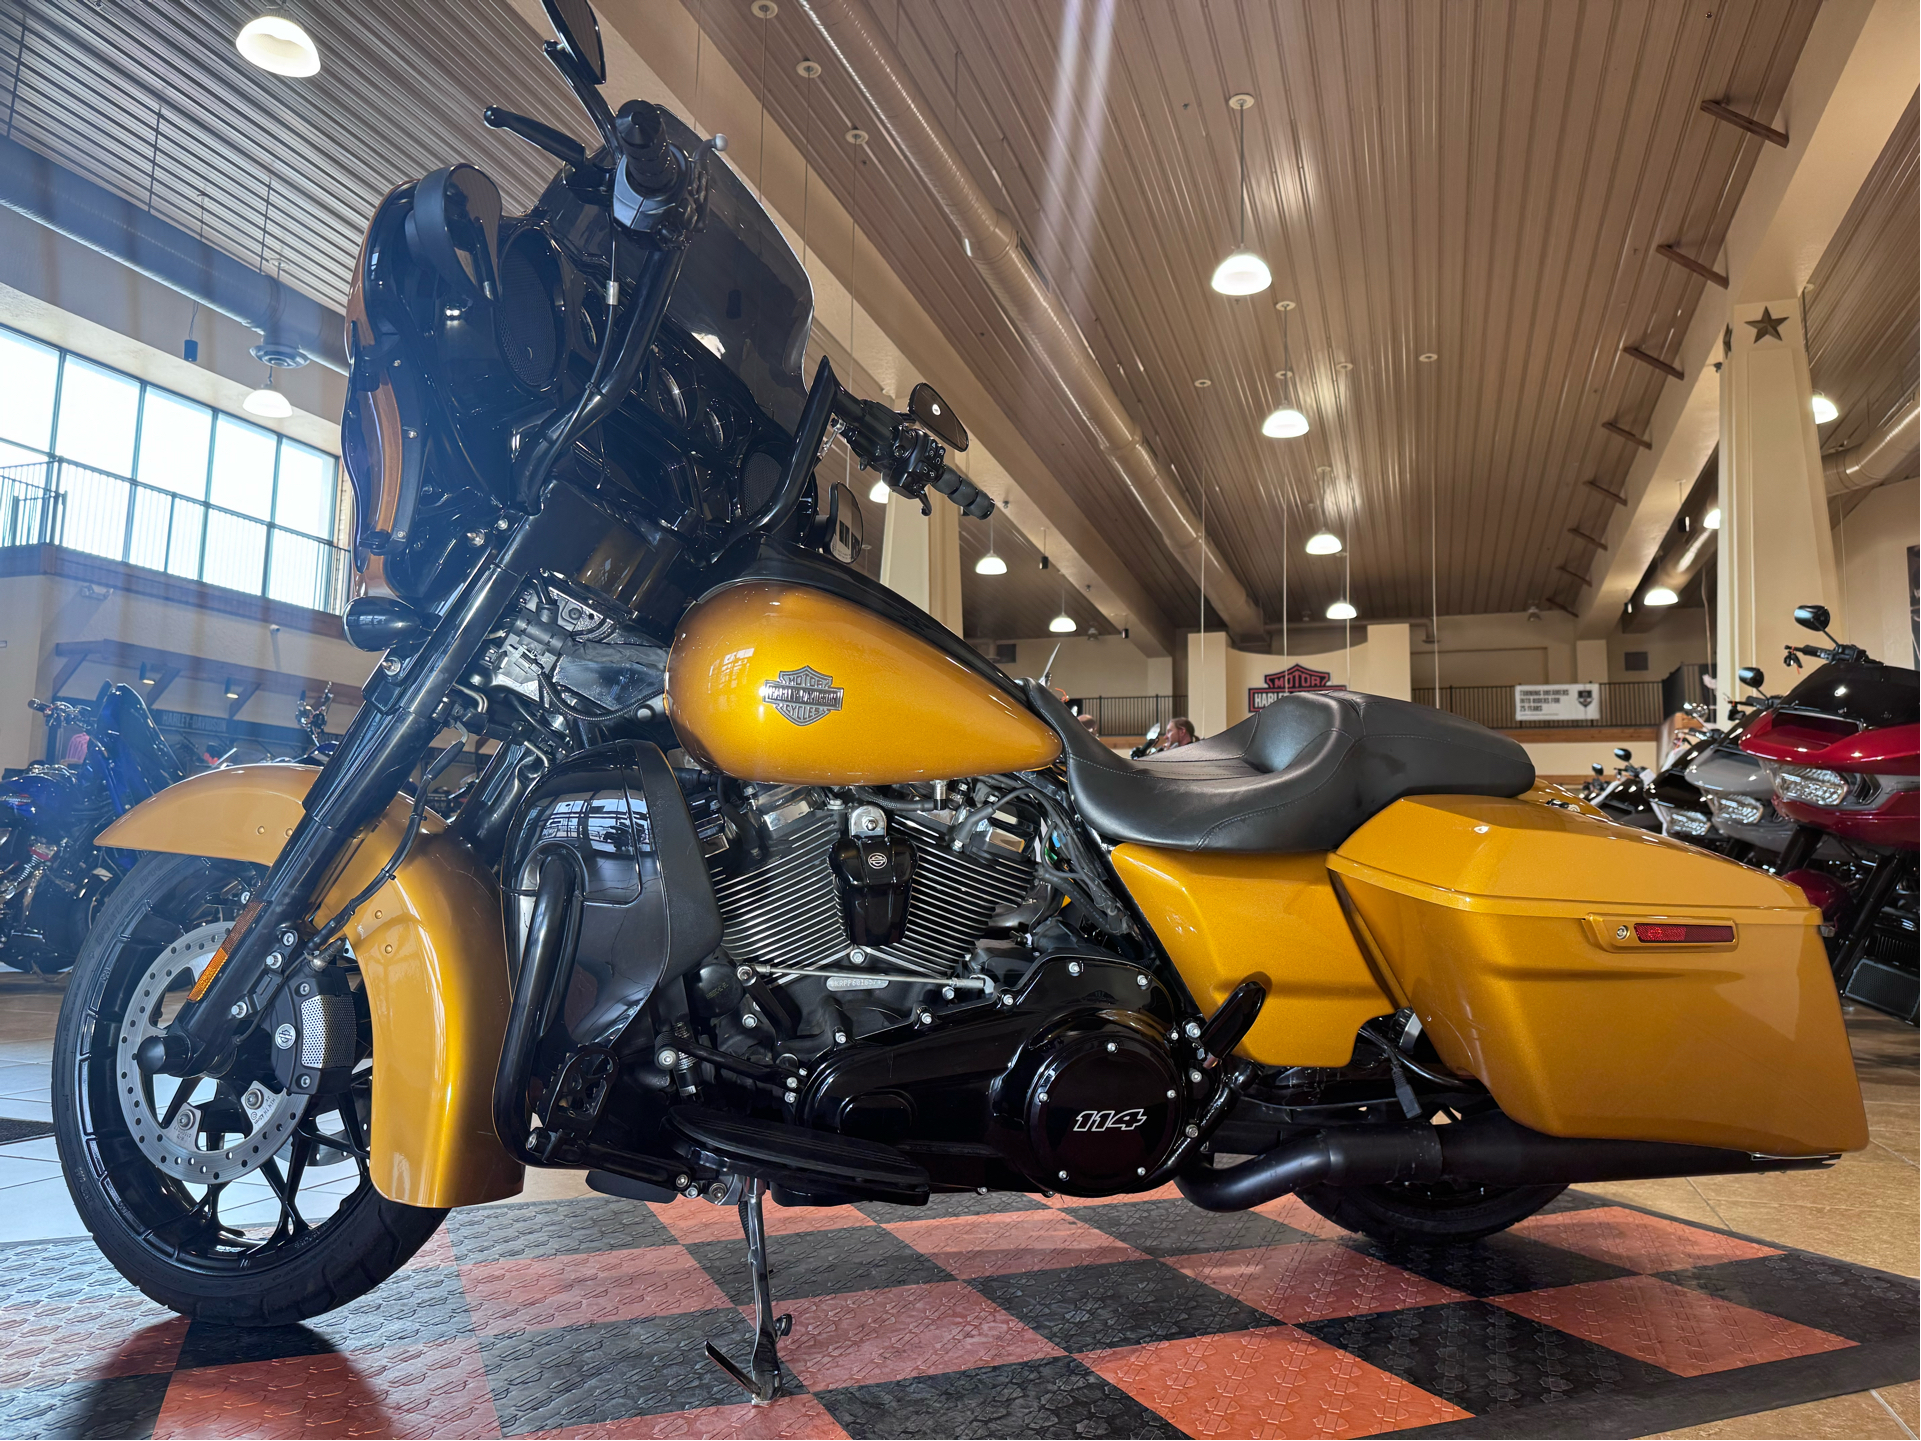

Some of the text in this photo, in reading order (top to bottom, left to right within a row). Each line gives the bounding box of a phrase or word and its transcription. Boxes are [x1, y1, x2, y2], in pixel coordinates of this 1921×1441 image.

[788, 674, 824, 687] MOTOR
[1275, 674, 1321, 688] MOTOR
[785, 704, 821, 720] CYCLES
[162, 711, 227, 732] HARLEY-DAVIDSON
[1073, 1109, 1147, 1131] 114
